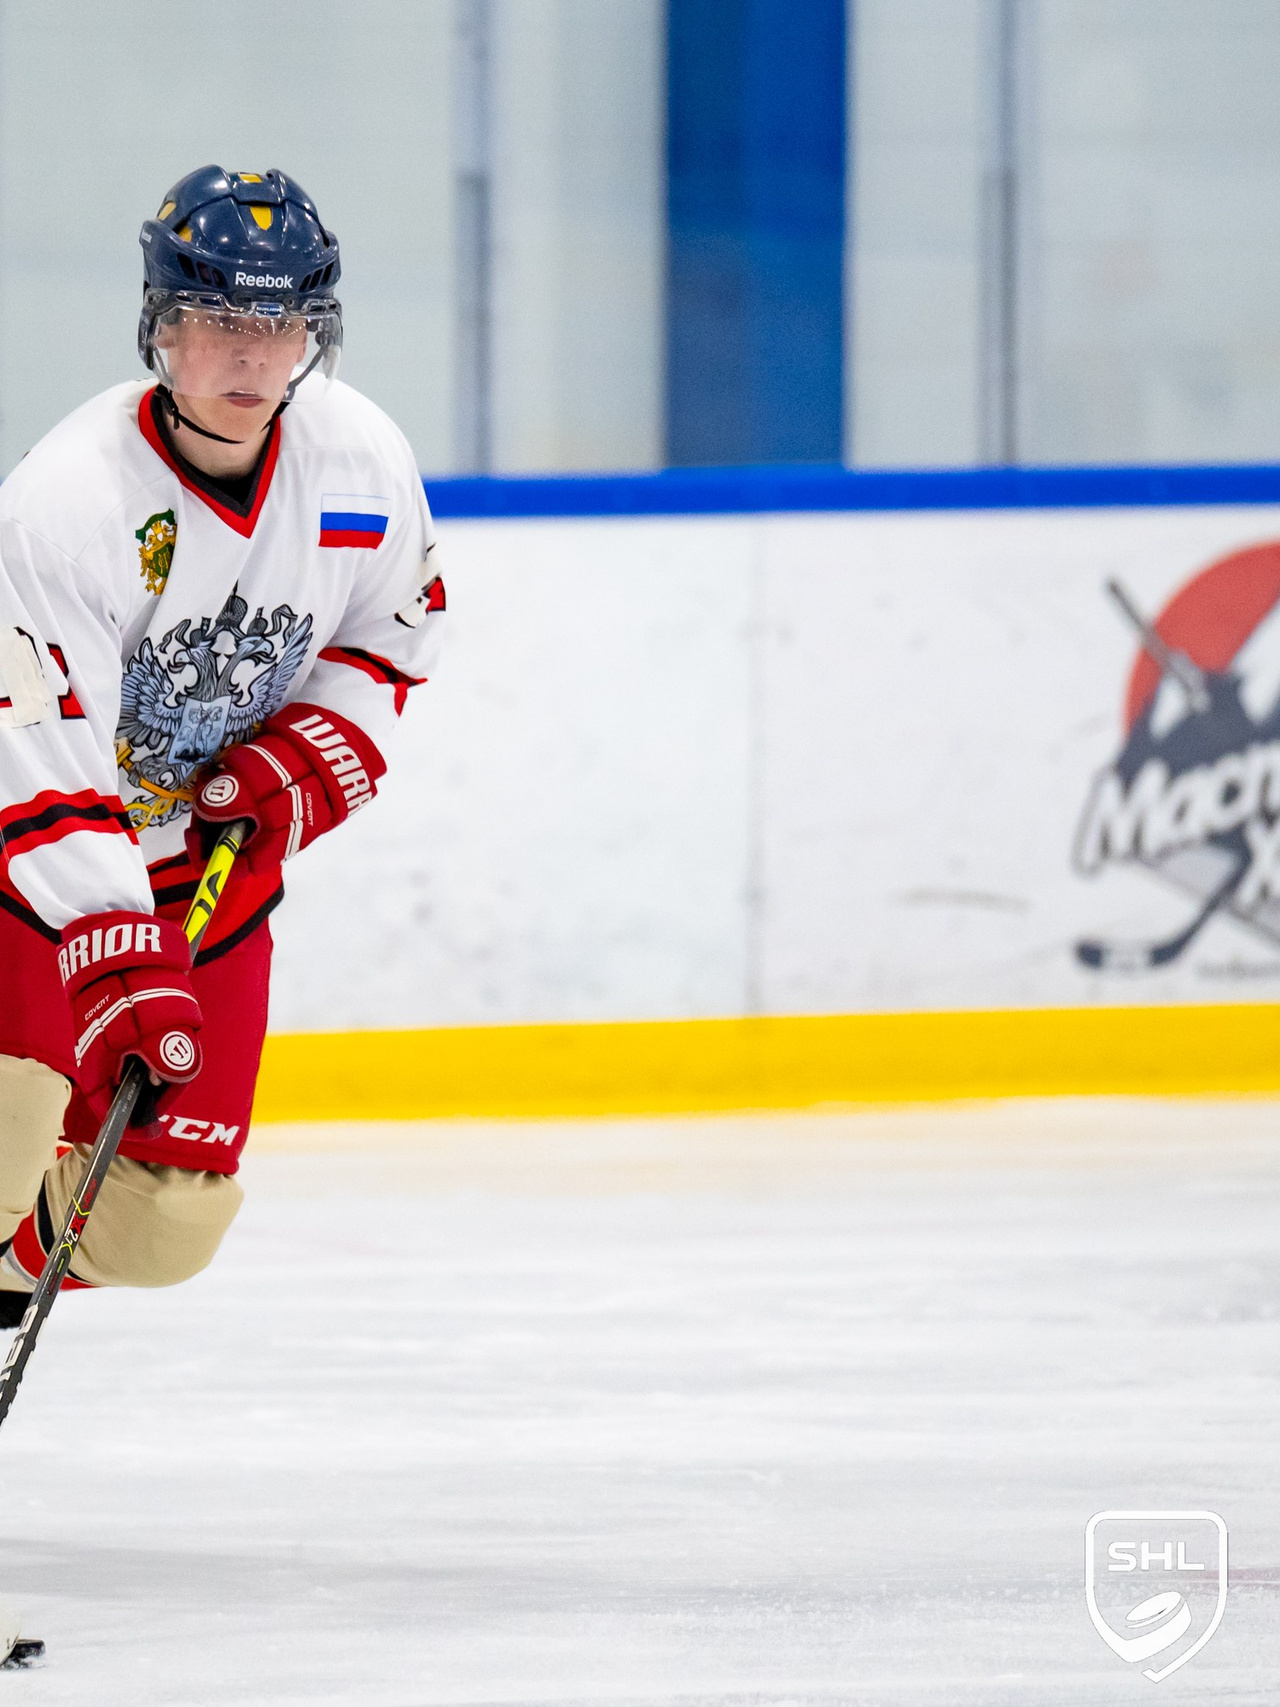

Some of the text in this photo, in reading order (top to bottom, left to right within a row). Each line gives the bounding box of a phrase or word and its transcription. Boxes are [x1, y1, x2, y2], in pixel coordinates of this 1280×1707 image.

[235, 271, 294, 289] Reebok
[305, 792, 314, 827] COVERT
[57, 923, 163, 990] RRIOR
[84, 994, 110, 1021] COVERT
[158, 1114, 240, 1147] CM
